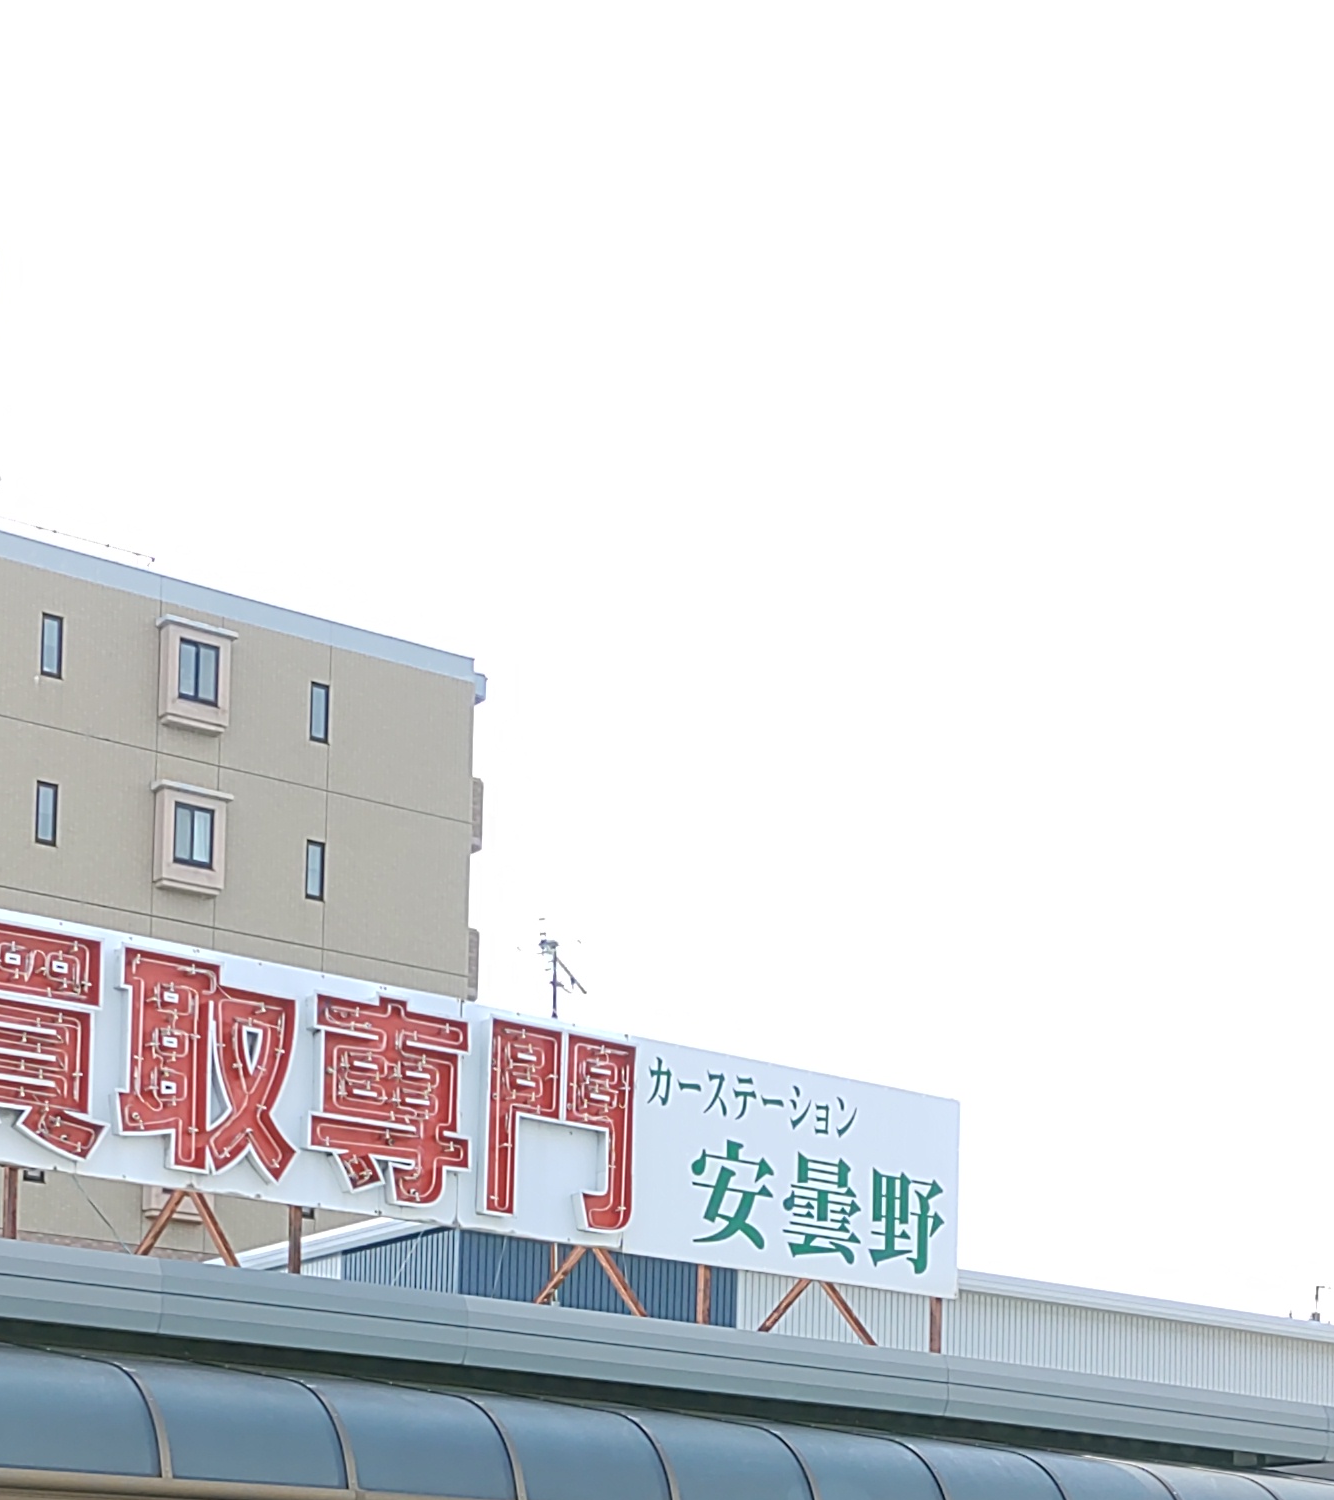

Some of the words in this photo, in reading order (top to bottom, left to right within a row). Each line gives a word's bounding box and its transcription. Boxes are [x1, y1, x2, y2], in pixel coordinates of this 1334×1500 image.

[647, 1056, 858, 1139] カーステーション
[691, 1138, 945, 1275] 安曇野
